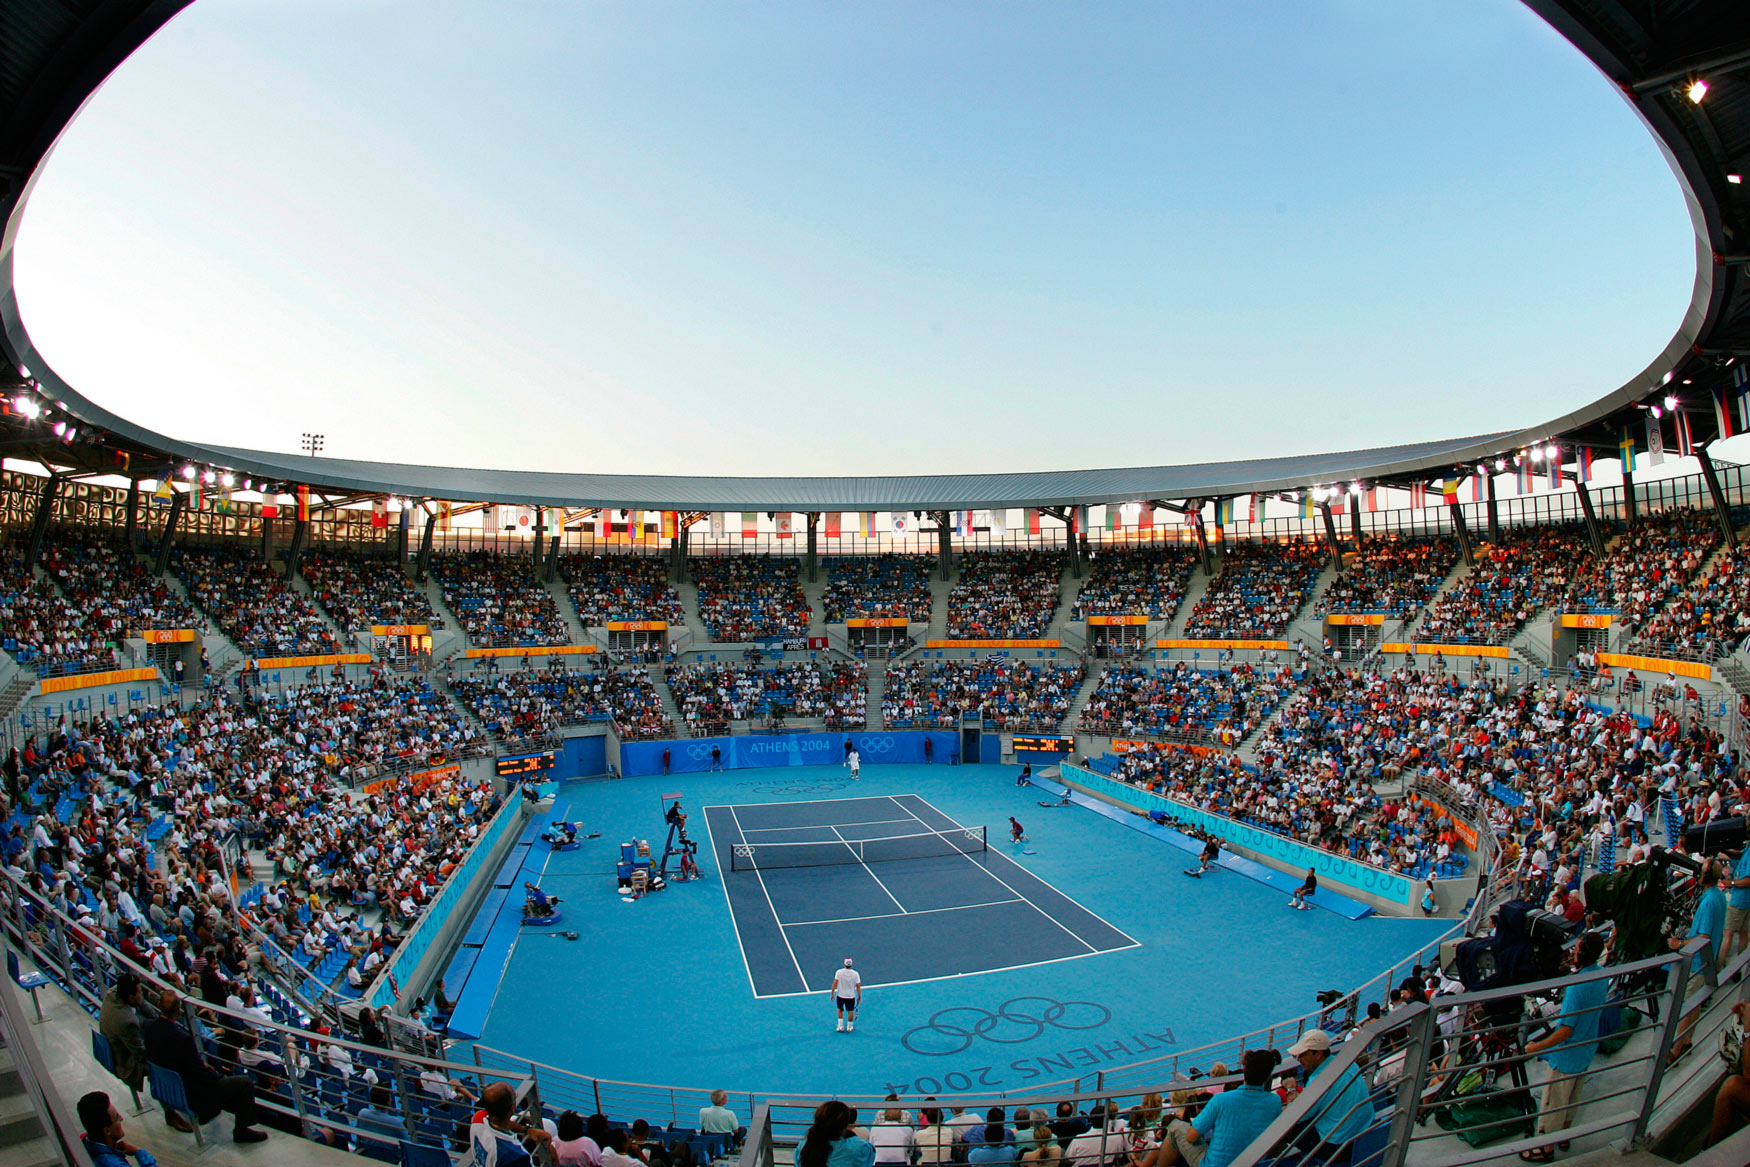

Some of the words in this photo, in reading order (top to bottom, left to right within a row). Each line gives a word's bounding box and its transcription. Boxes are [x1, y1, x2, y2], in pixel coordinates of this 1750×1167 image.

[750, 740, 799, 753] ATHENS
[801, 740, 830, 751] 2004
[1010, 1027, 1176, 1078] ATHENS
[883, 1066, 1003, 1094] 2004
